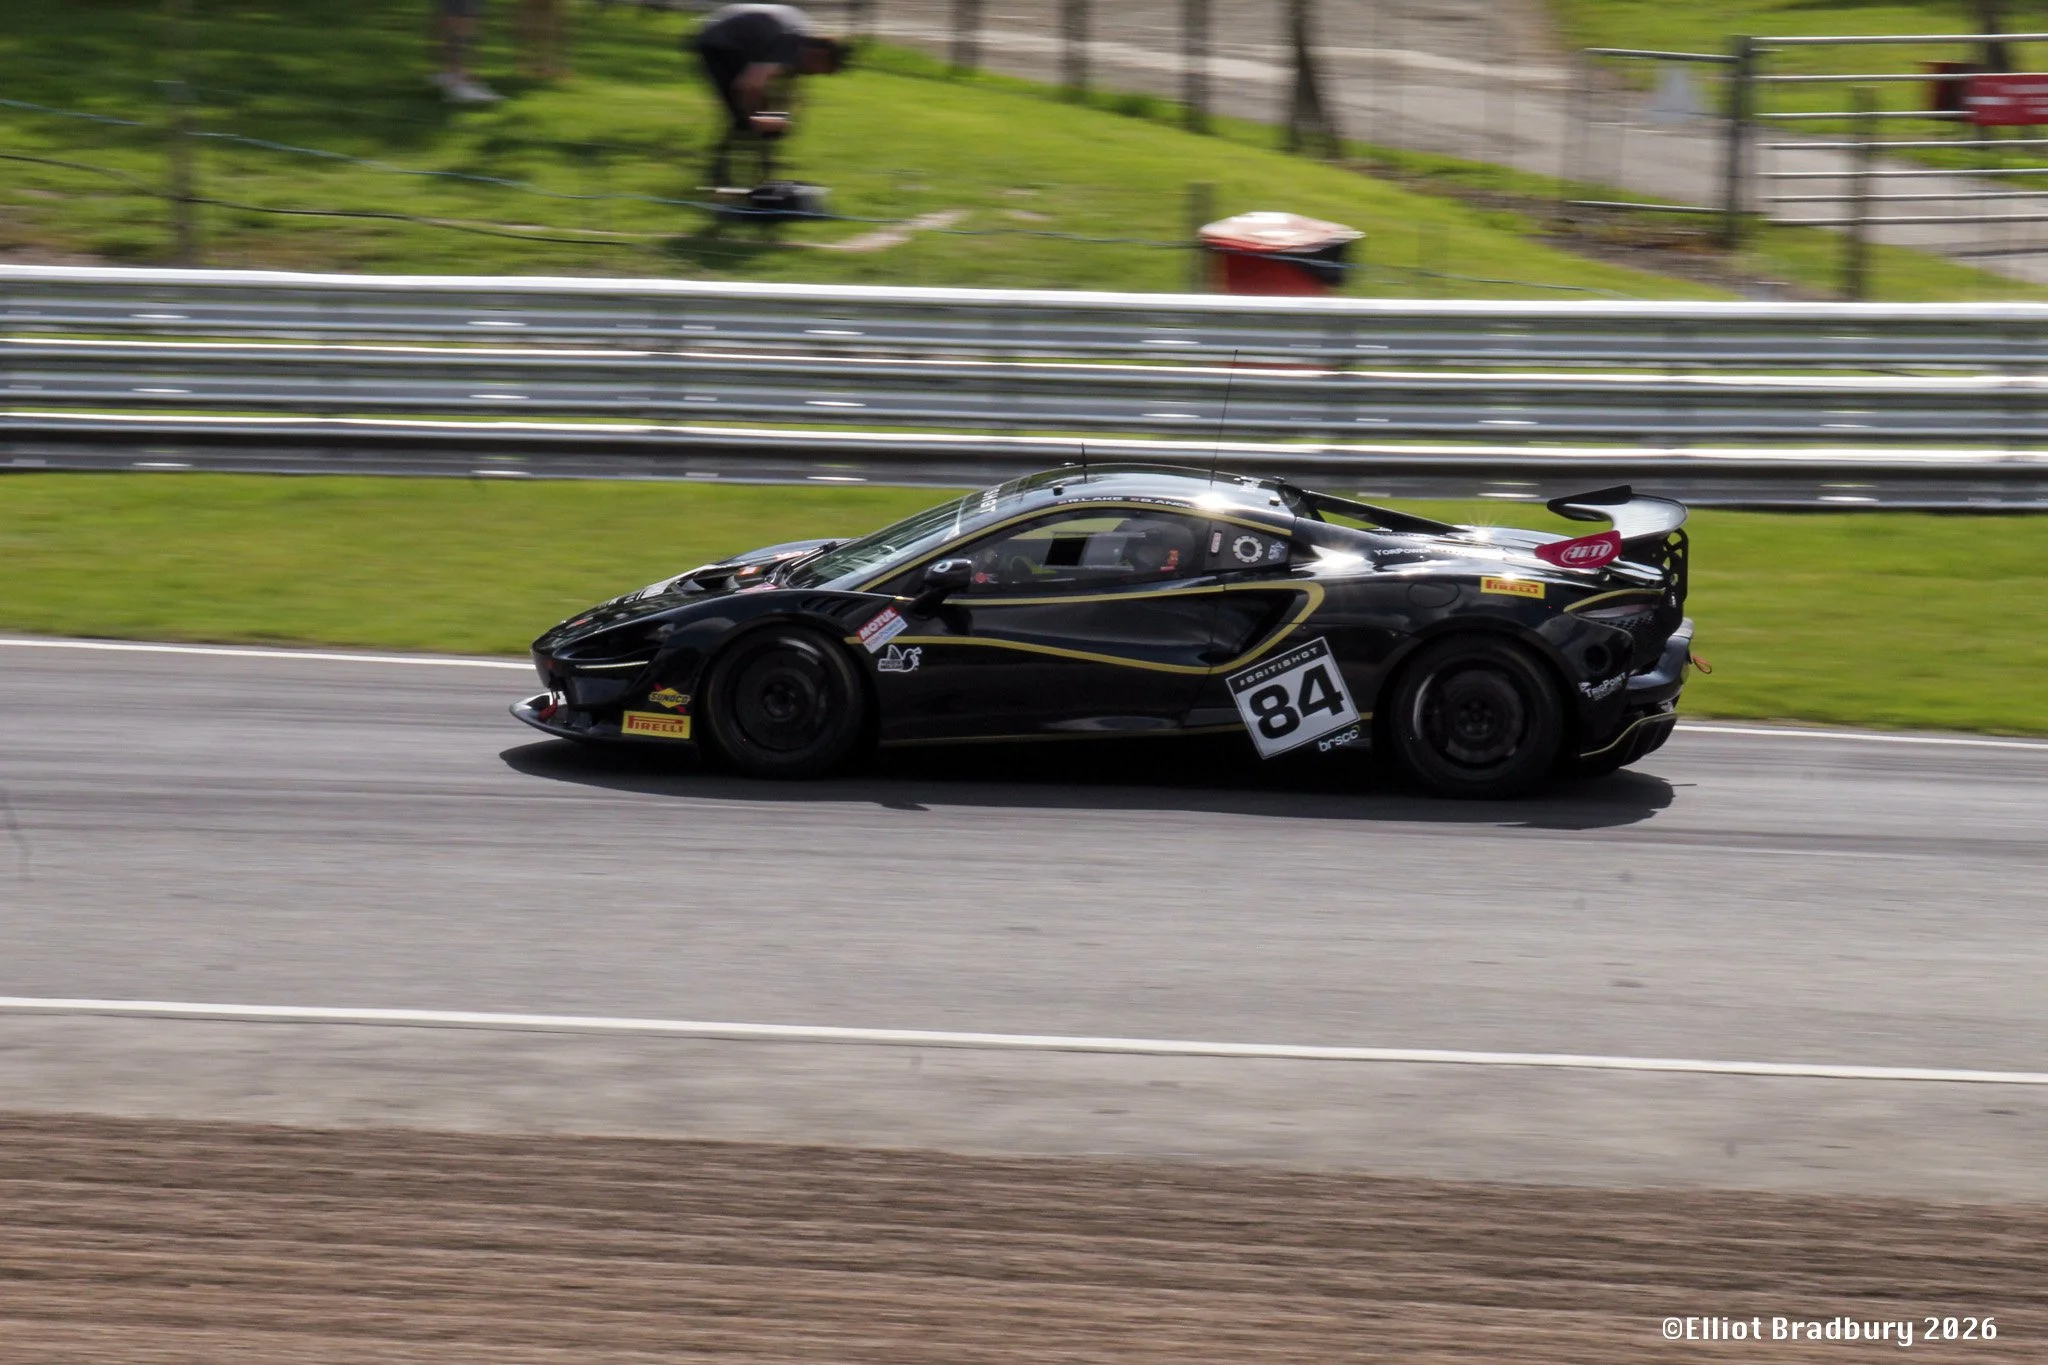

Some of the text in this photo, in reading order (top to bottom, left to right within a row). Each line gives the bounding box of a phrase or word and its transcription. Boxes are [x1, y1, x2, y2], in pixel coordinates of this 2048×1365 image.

[1486, 579, 1539, 594] PIRELLI
[859, 608, 896, 640] MOTUL
[649, 692, 689, 704] SUNOCO
[1249, 663, 1345, 740] 84
[626, 715, 685, 733] PIRELLI
[1318, 726, 1361, 752] brscc
